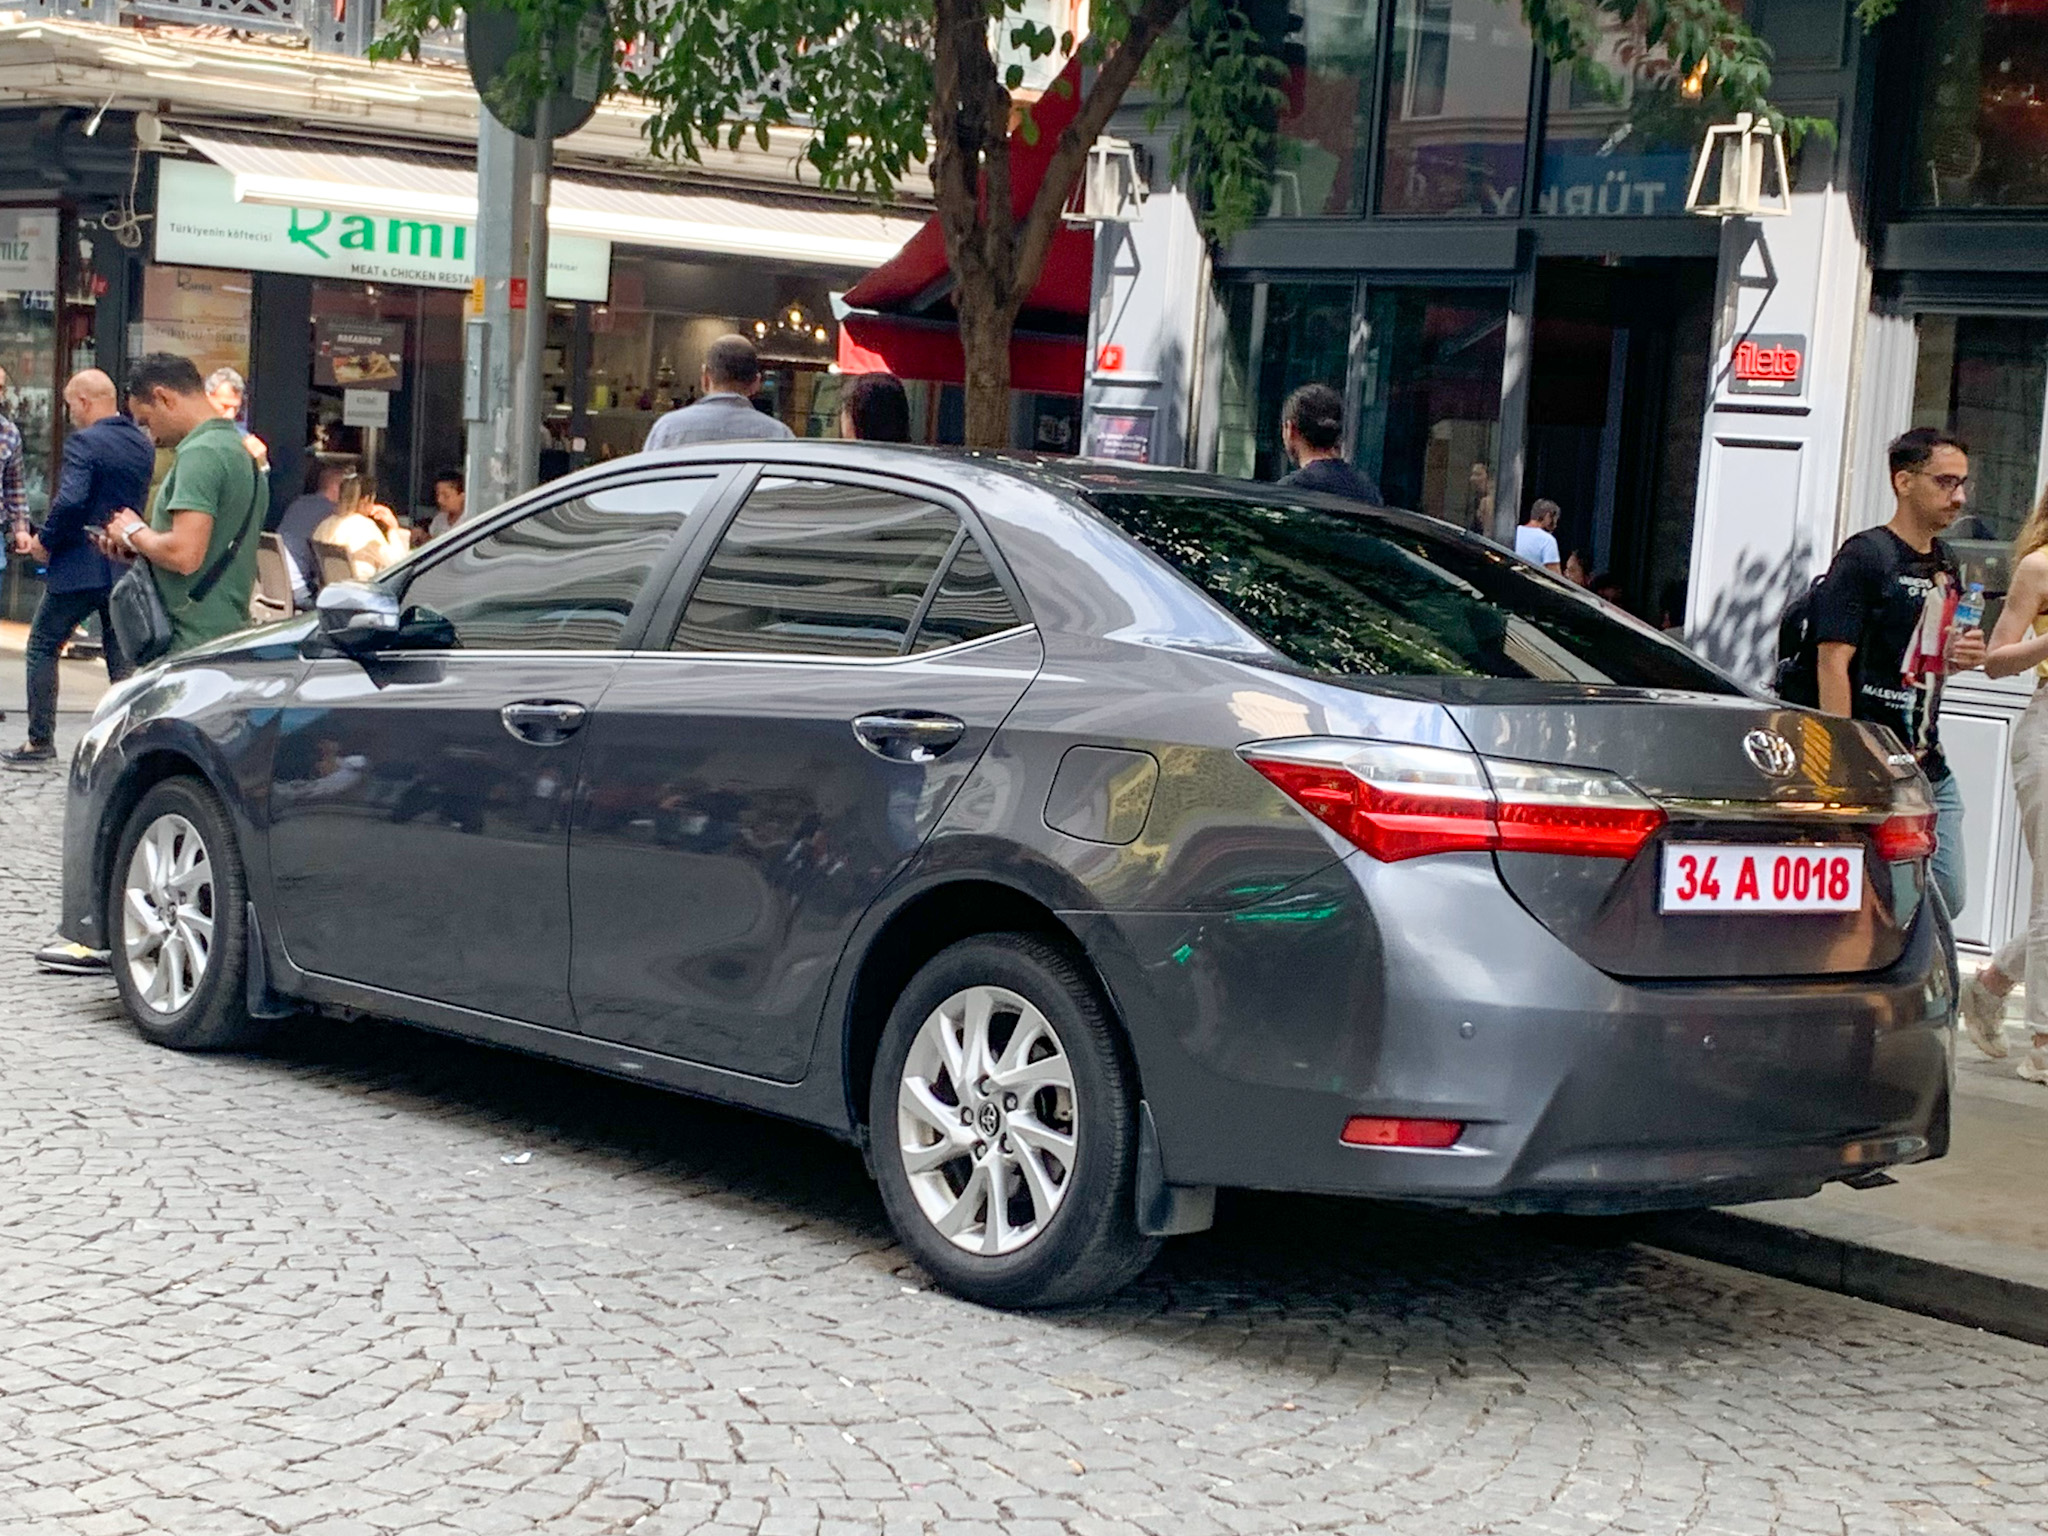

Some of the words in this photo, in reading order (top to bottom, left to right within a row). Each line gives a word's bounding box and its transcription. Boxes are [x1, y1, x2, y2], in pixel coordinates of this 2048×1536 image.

[351, 264, 379, 277] MEAT
[391, 267, 436, 282] CHICKEN
[438, 272, 475, 284] RESTA
[1676, 855, 1721, 901] 34
[1733, 856, 1761, 901] A
[1773, 855, 1850, 901] 0018
